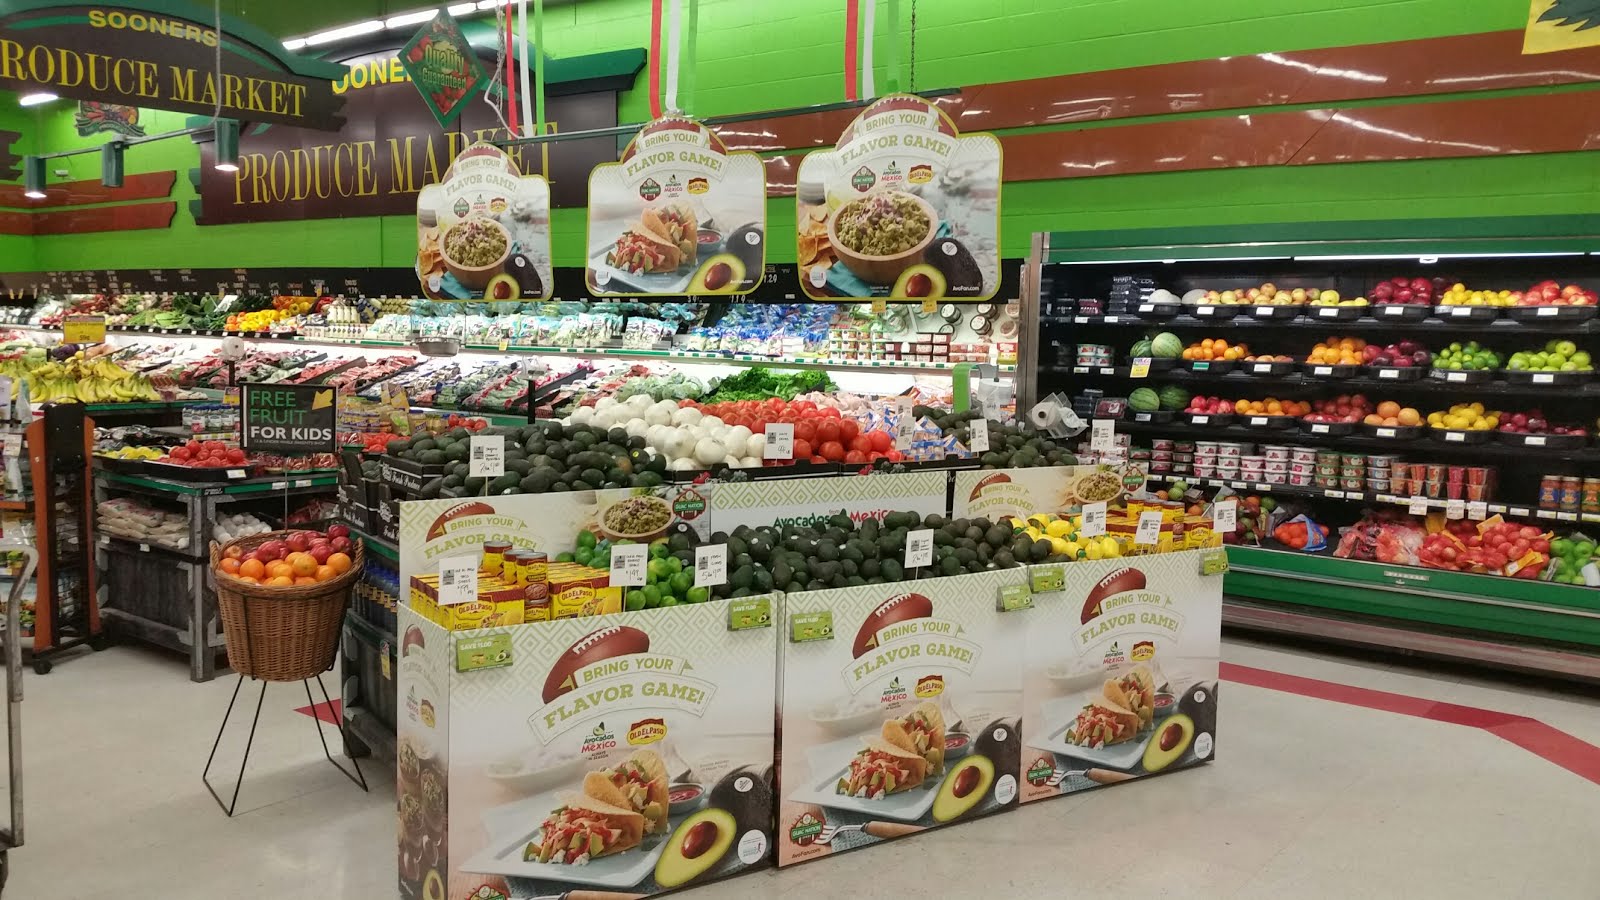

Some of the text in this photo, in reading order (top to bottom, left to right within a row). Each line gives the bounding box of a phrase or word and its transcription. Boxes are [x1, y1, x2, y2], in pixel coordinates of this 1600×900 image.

[88, 10, 218, 47] SOONERS
[425, 43, 465, 75] Quality
[0, 38, 307, 118] RODUCE MARKET
[422, 67, 467, 89] Guaranteed
[865, 114, 927, 131] BRING YOUR
[645, 133, 699, 148] BRING YOUR
[841, 135, 951, 165] FLAVOR GAME!
[233, 140, 378, 206] PRODUCE
[460, 158, 501, 170] BRING YOUR
[627, 151, 722, 176] FLAVOR GAME!
[446, 174, 517, 196] FLAVOR GAME!
[251, 391, 296, 407] FREE
[250, 409, 307, 424] FRUIT
[251, 426, 332, 441] FOR KIDS
[984, 485, 1003, 494] BRING
[968, 497, 1004, 515] FLAVOR
[450, 517, 513, 531] BRING YOUR
[773, 512, 830, 529] Avocados
[850, 509, 896, 523] Mexic
[424, 533, 537, 559] FLAVOR GAME!
[1105, 593, 1160, 610] BRING YOUR
[883, 621, 950, 641] BRING YOUR
[1081, 612, 1178, 644] FLAVOR GAME!
[583, 658, 673, 683] BRING YOUR
[853, 643, 974, 680] FLAVOR GAME!
[543, 681, 704, 729] FLAVOR GAME!
[581, 740, 616, 753] Mexico
[583, 734, 615, 745] Avocados
